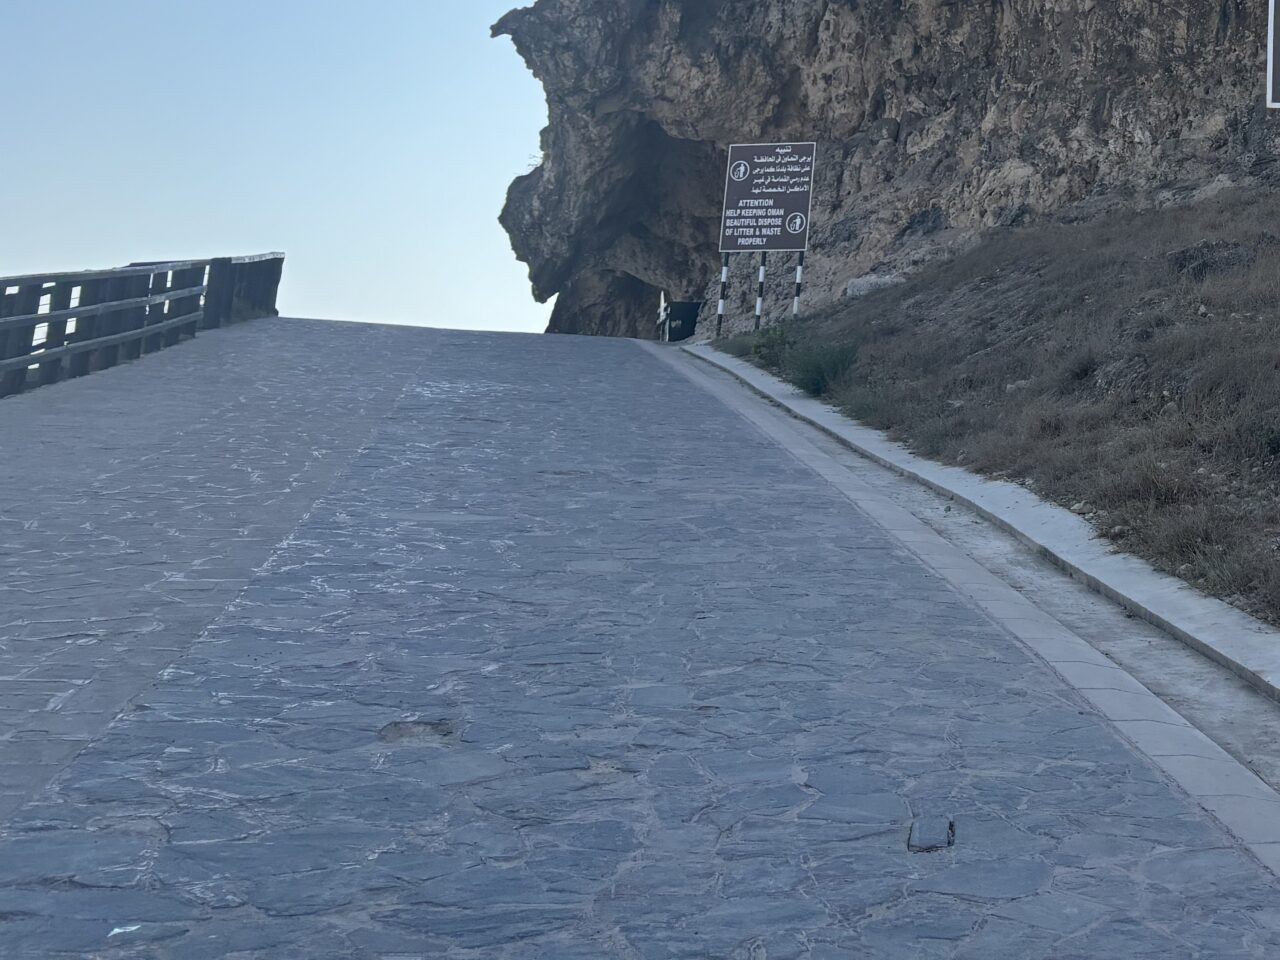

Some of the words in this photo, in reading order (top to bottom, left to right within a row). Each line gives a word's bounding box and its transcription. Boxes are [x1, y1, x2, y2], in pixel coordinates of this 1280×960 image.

[775, 146, 792, 154] تنبيه
[738, 199, 774, 207] ATTENTION
[741, 208, 766, 216] KEEPING
[767, 208, 784, 216] OMAN
[726, 218, 757, 226] BEAUTIFUL
[758, 218, 782, 226] DISPOSE
[725, 228, 734, 236] OF
[734, 228, 754, 236] LITTER
[761, 227, 782, 235] WASTE
[737, 237, 767, 245] PROPERLY
